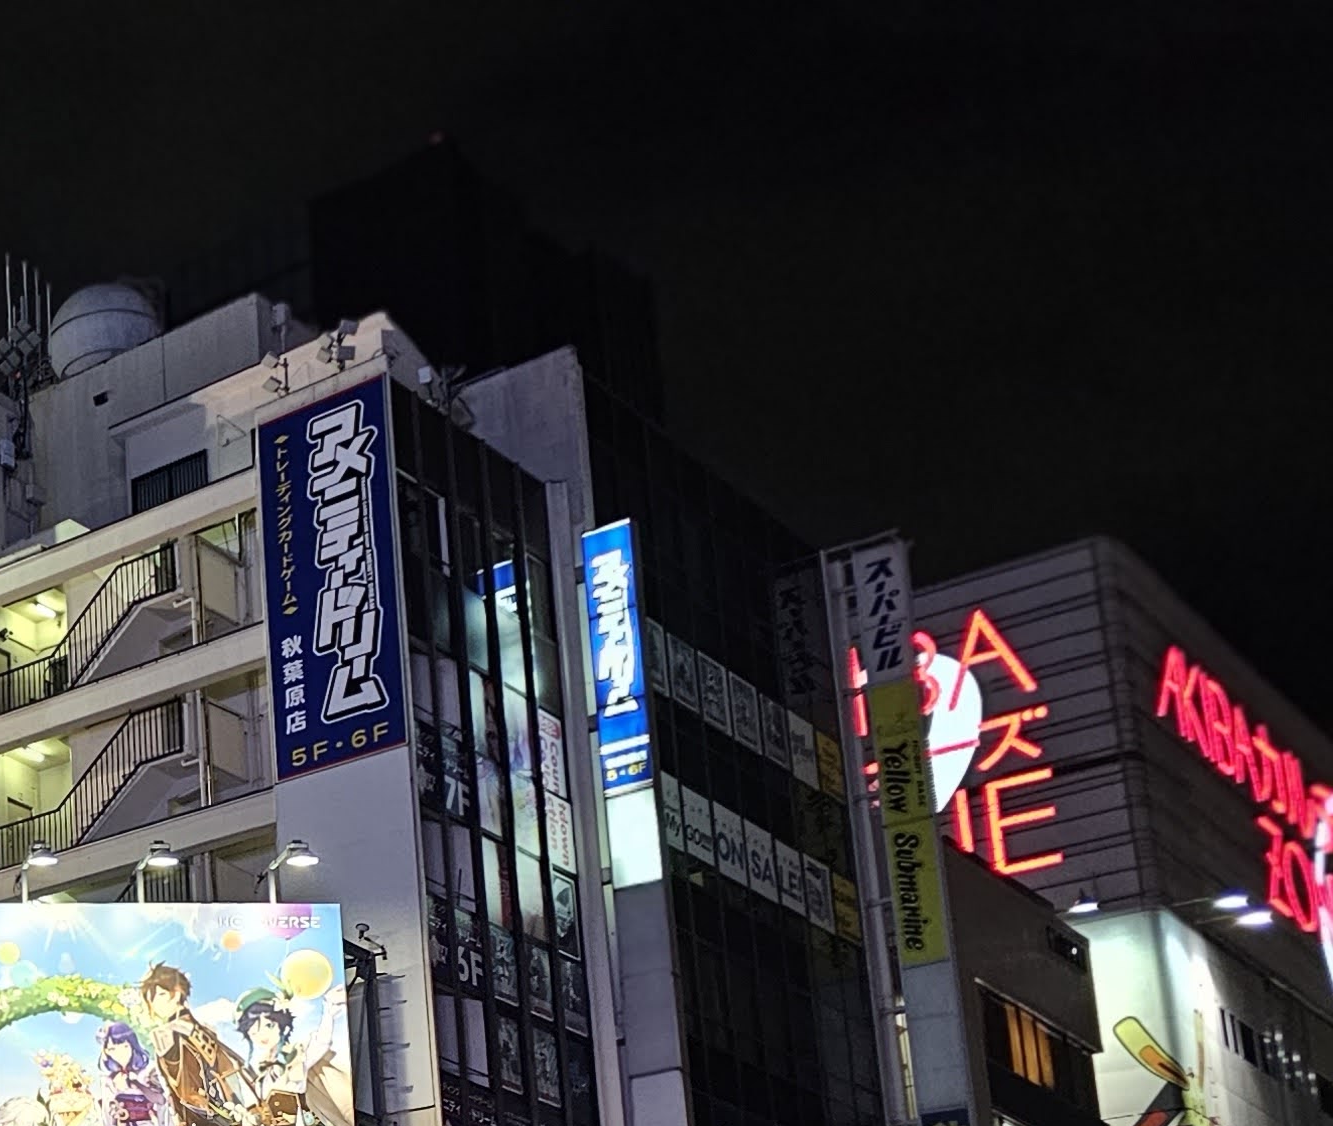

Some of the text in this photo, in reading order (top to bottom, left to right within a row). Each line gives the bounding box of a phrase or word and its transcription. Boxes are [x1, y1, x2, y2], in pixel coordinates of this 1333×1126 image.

[863, 556, 904, 673] スーパービル
[280, 636, 308, 735] 秋葉原店
[443, 774, 470, 816] 7F
[882, 741, 911, 815] Yellow
[717, 837, 744, 869] ON
[217, 916, 321, 929] HOVERSE
[893, 832, 932, 952] Submarine
